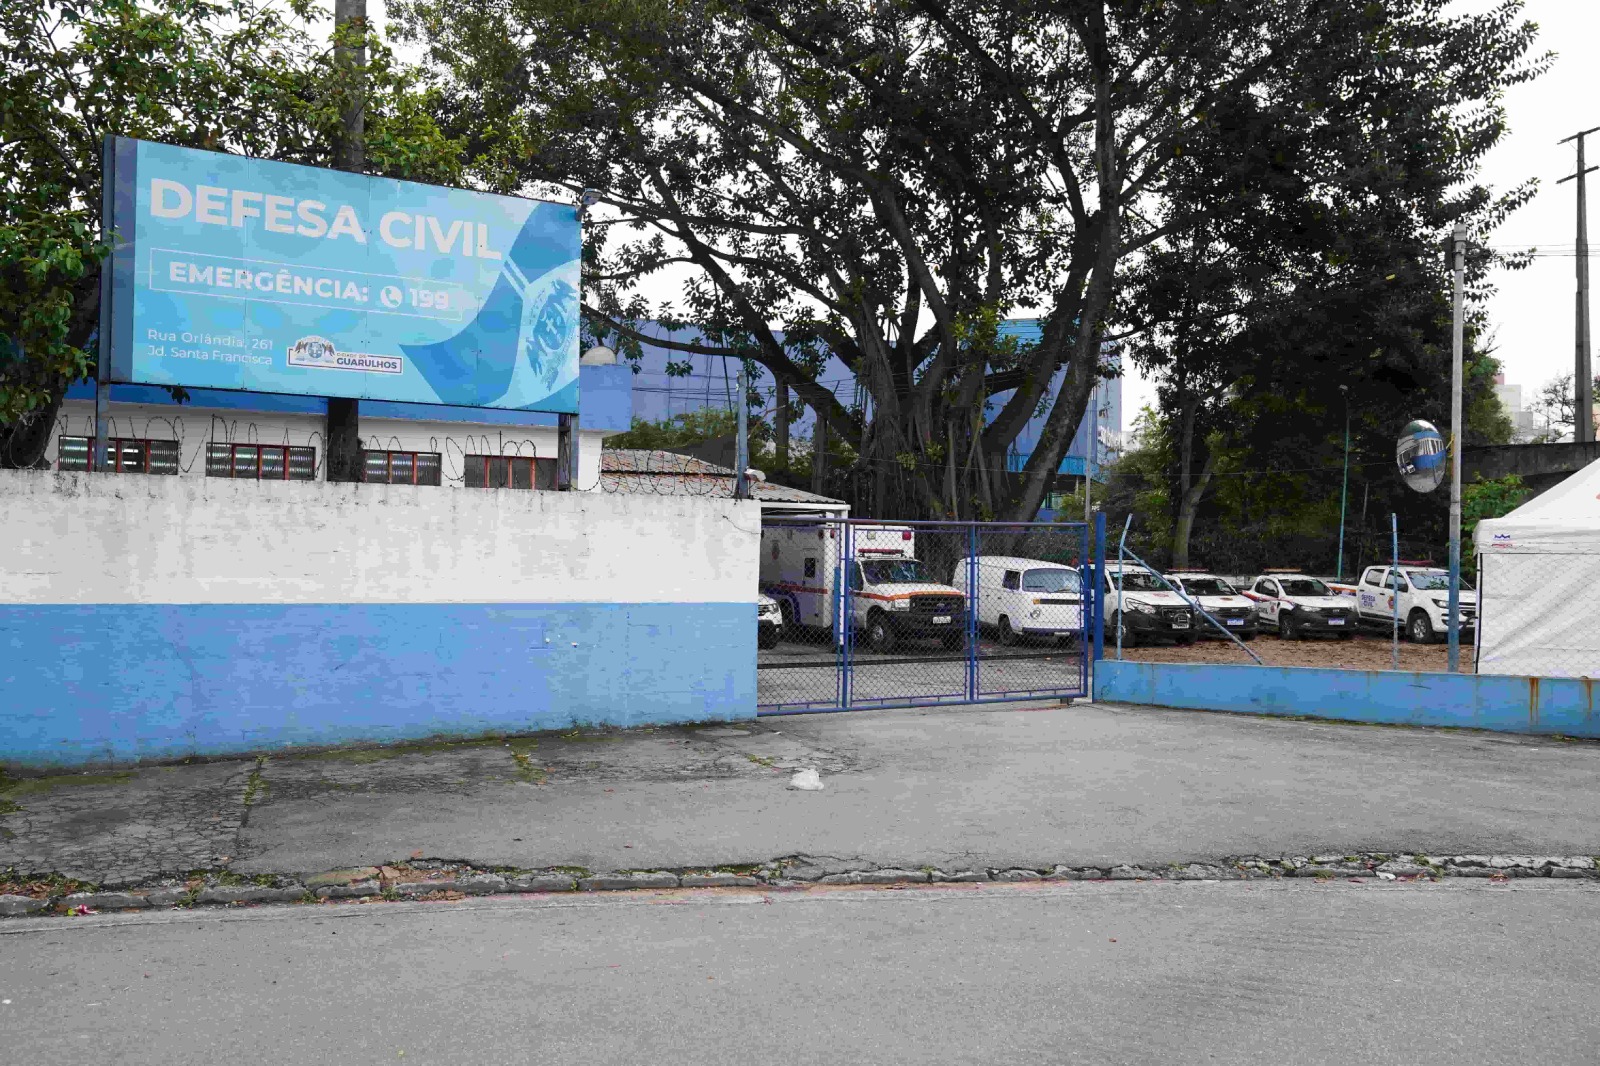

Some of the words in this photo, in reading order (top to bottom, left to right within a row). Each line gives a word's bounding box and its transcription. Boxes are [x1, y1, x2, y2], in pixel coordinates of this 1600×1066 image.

[150, 178, 367, 244] DEFESA
[379, 211, 502, 260] CIVIL
[169, 261, 369, 302] EMERGÊNCIA:
[409, 287, 449, 309] 199
[147, 329, 177, 342] Rua
[181, 332, 248, 349] Orlândia,
[252, 338, 273, 350] 261
[147, 345, 167, 357] Jd.
[170, 346, 209, 360] Santa
[212, 350, 273, 365] Francisca
[336, 357, 398, 370] GUARULHOS
